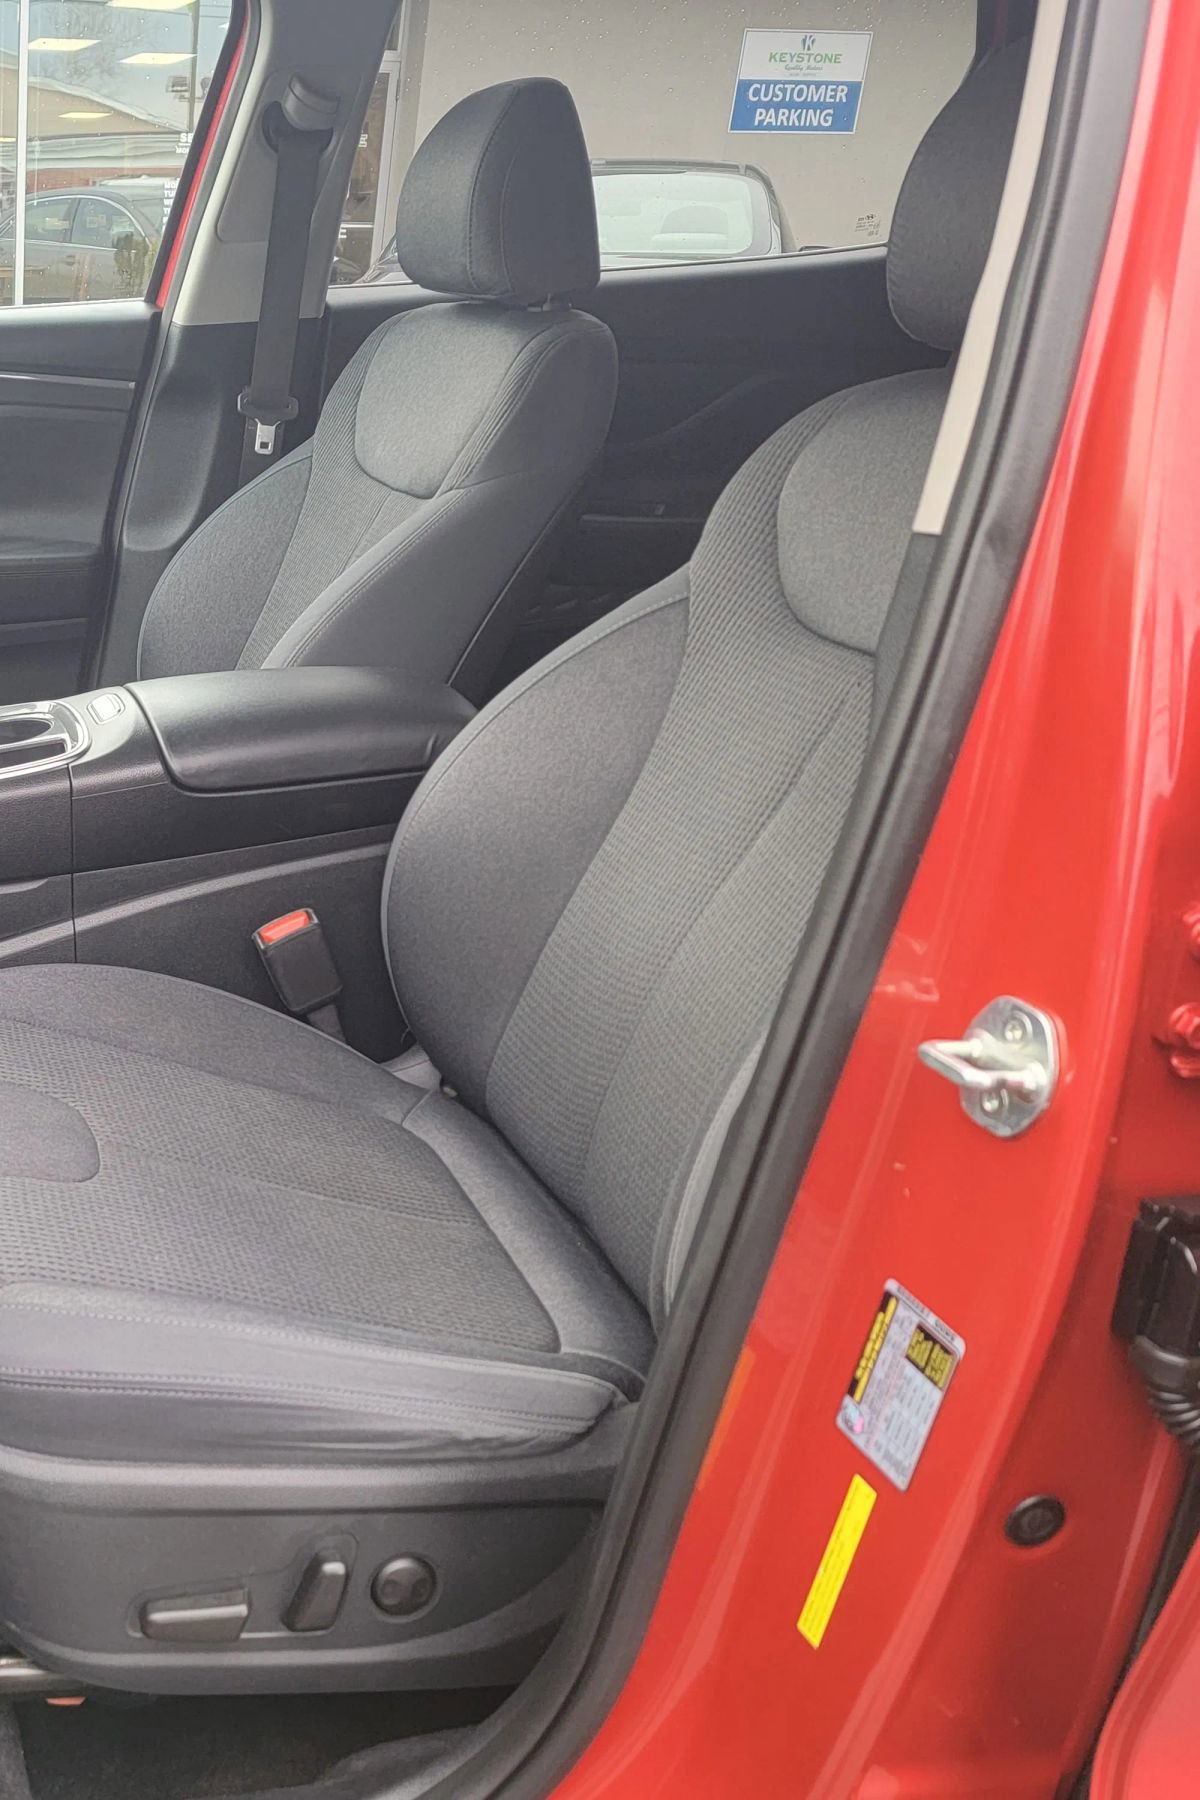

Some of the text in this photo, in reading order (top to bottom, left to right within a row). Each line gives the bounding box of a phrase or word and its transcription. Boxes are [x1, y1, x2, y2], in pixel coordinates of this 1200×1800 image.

[768, 52, 842, 64] KEYSTONE
[748, 83, 848, 103] CUSTOMER
[754, 108, 834, 126] PARKING
